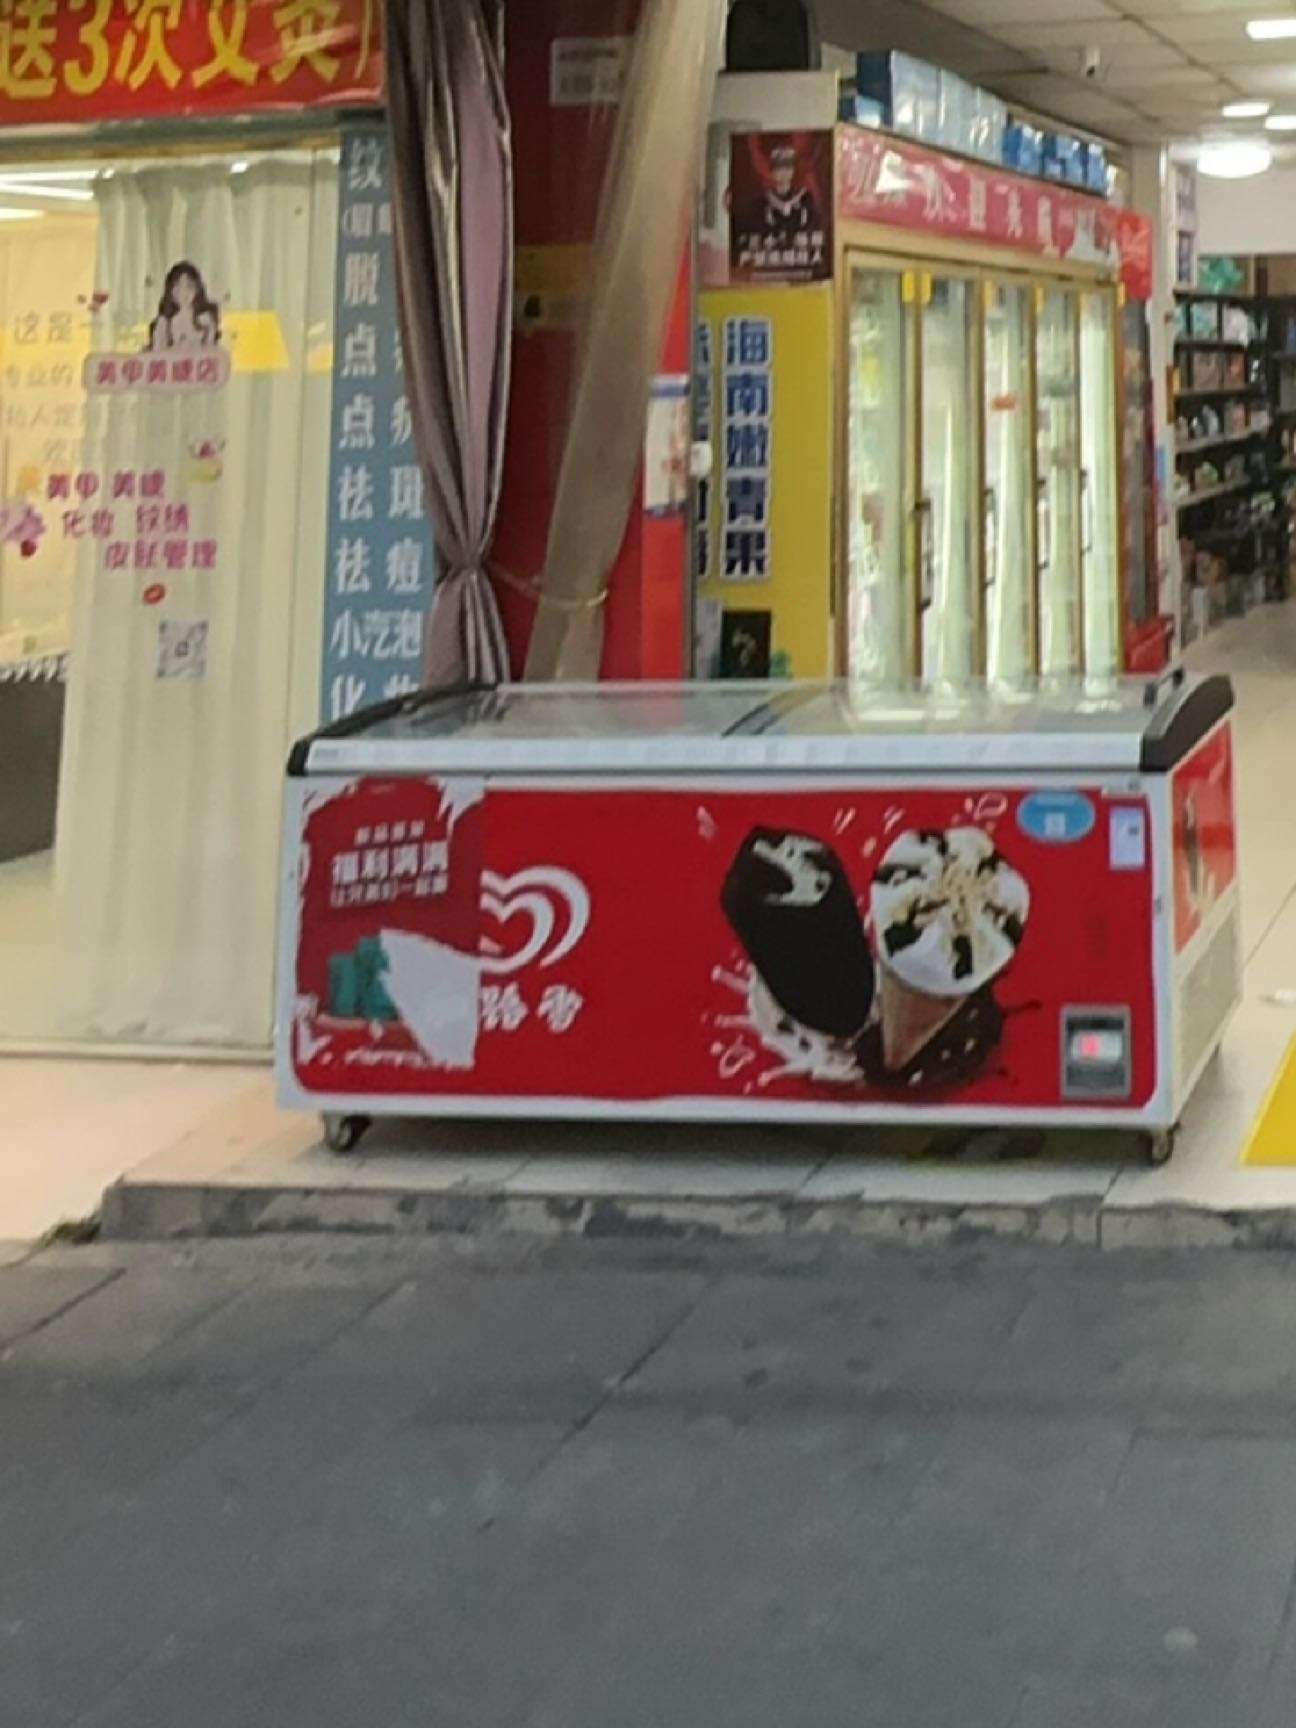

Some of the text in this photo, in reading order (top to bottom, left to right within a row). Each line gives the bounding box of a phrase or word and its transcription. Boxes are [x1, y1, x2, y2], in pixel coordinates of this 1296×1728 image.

[725, 318, 769, 576] 海南嫩青果
[334, 535, 424, 594] 祛痘
[329, 608, 423, 663] 小汽泡
